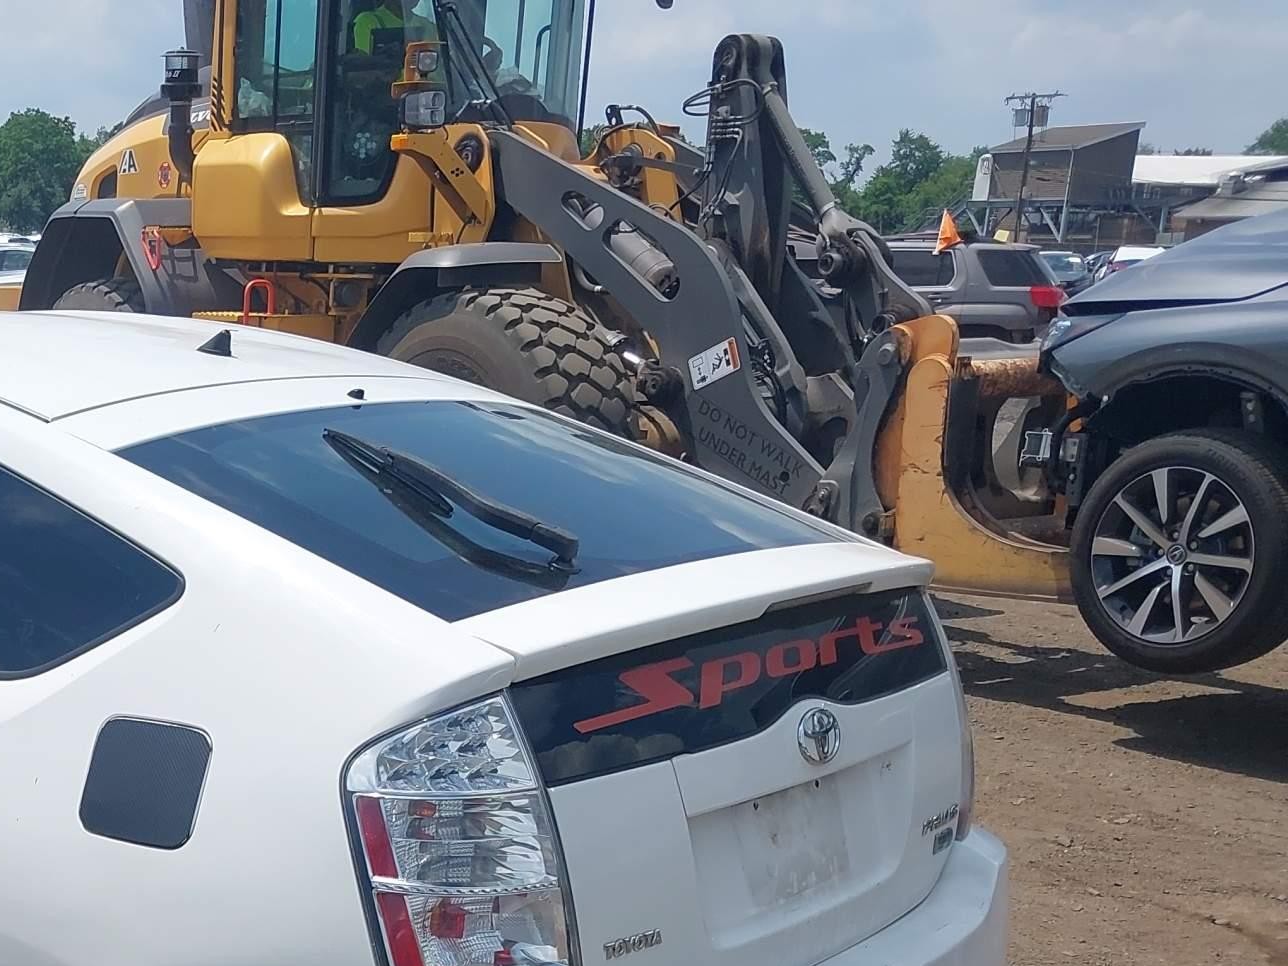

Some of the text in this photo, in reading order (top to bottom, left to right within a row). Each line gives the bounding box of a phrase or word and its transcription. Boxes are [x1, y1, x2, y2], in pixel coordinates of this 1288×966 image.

[698, 400, 804, 479] DO NOT WALK
[698, 427, 791, 495] UNDER MAST
[573, 616, 924, 734] Sports
[603, 928, 663, 960] TOYOTA
